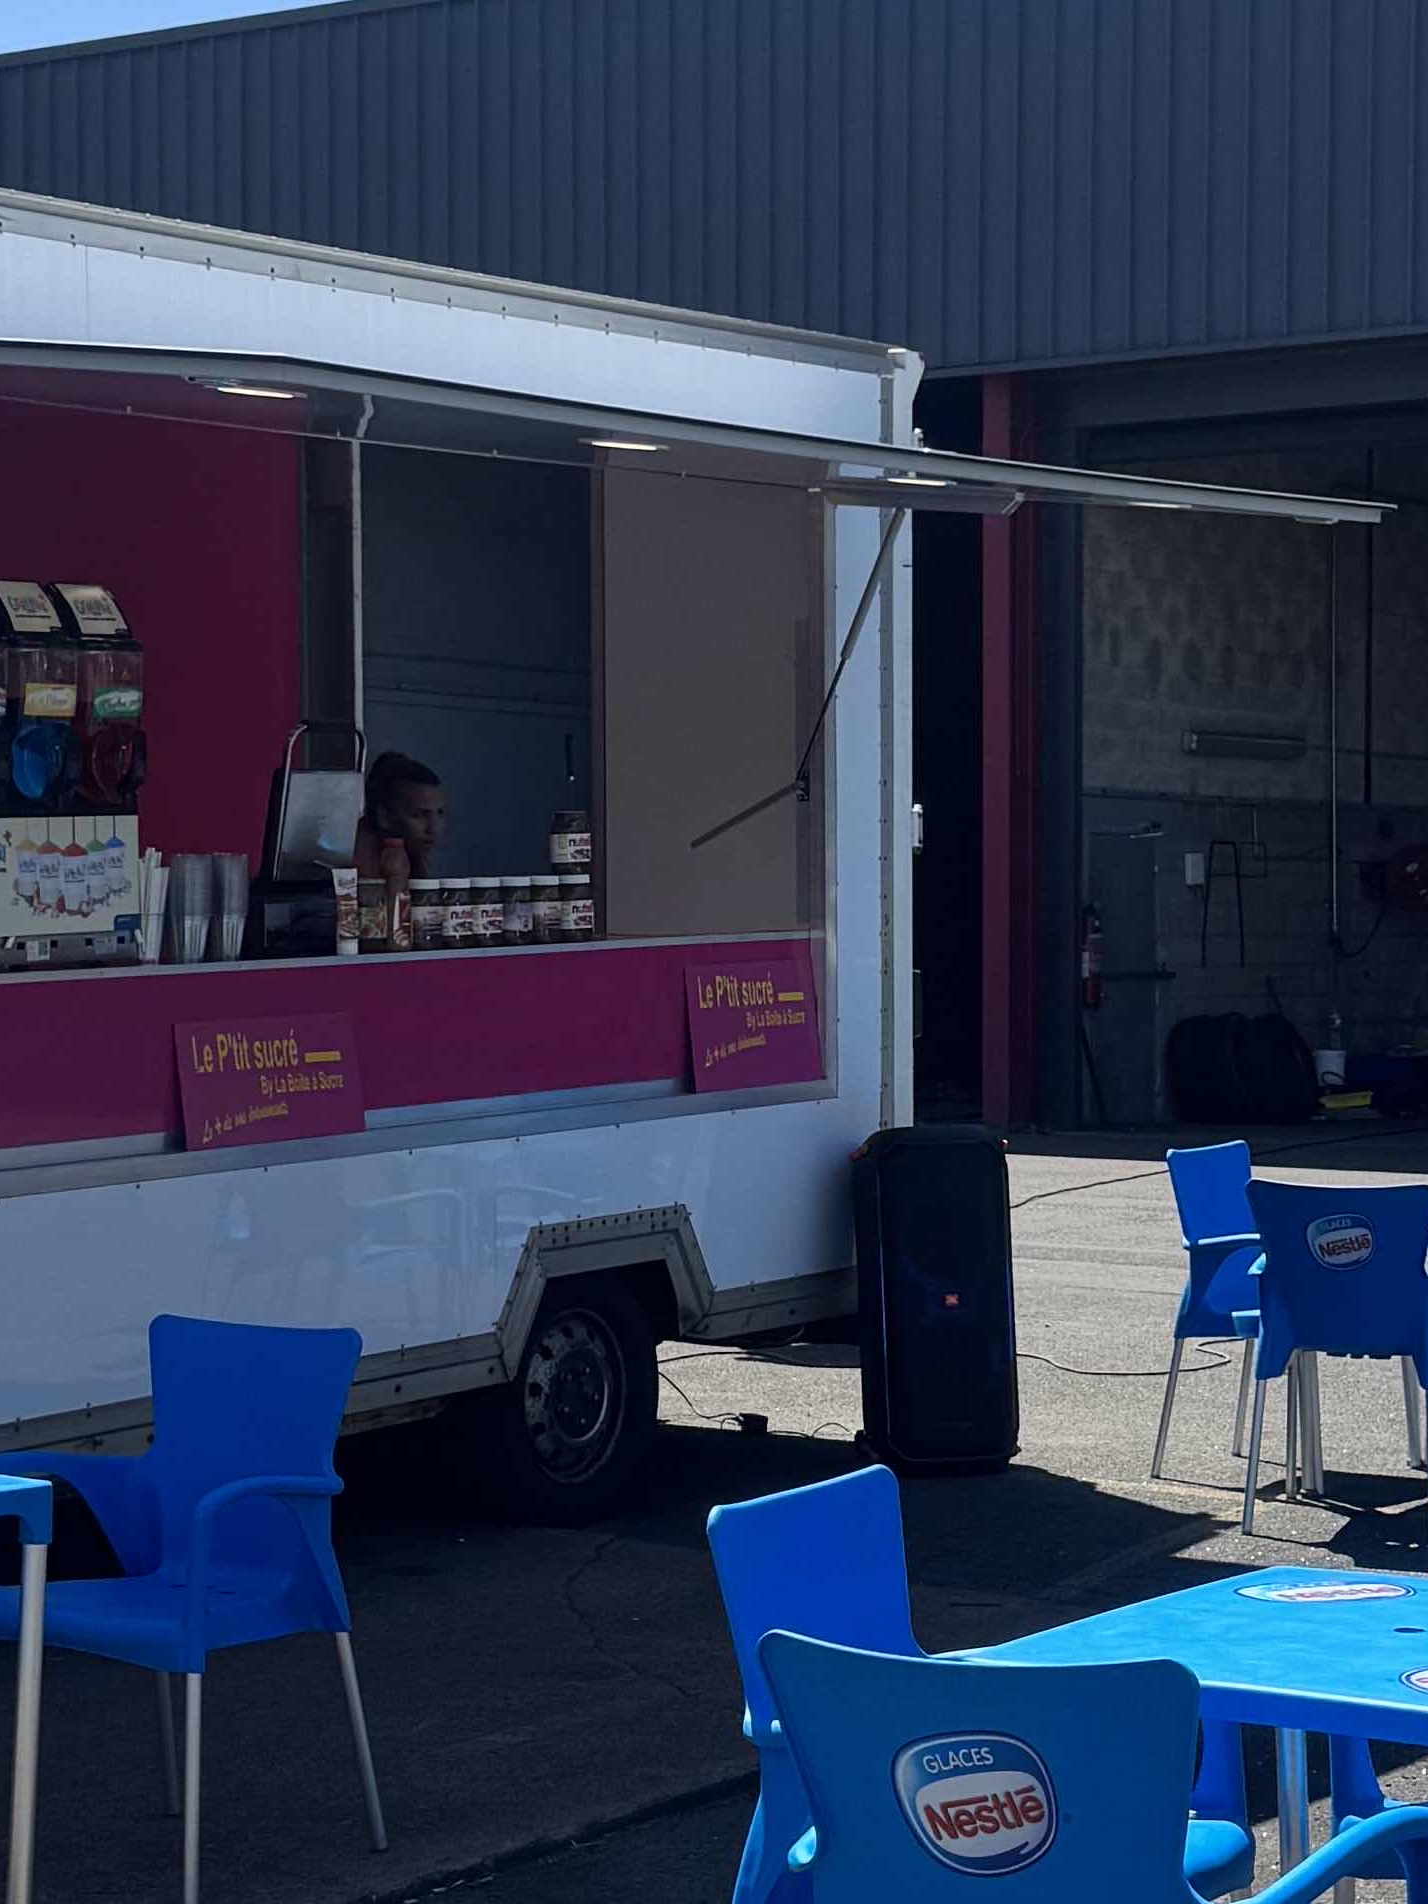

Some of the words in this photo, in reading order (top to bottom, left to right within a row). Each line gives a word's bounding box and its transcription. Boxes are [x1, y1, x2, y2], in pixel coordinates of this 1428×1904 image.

[697, 975, 713, 1008] Le
[742, 970, 773, 1006] sucré
[191, 1035, 212, 1073] Le
[216, 1032, 250, 1072] P'tit
[253, 1028, 297, 1068] sucré
[1319, 1233, 1371, 1259] Nestlé
[922, 1747, 995, 1775] GLACES
[923, 1784, 1046, 1842] Nestlé
